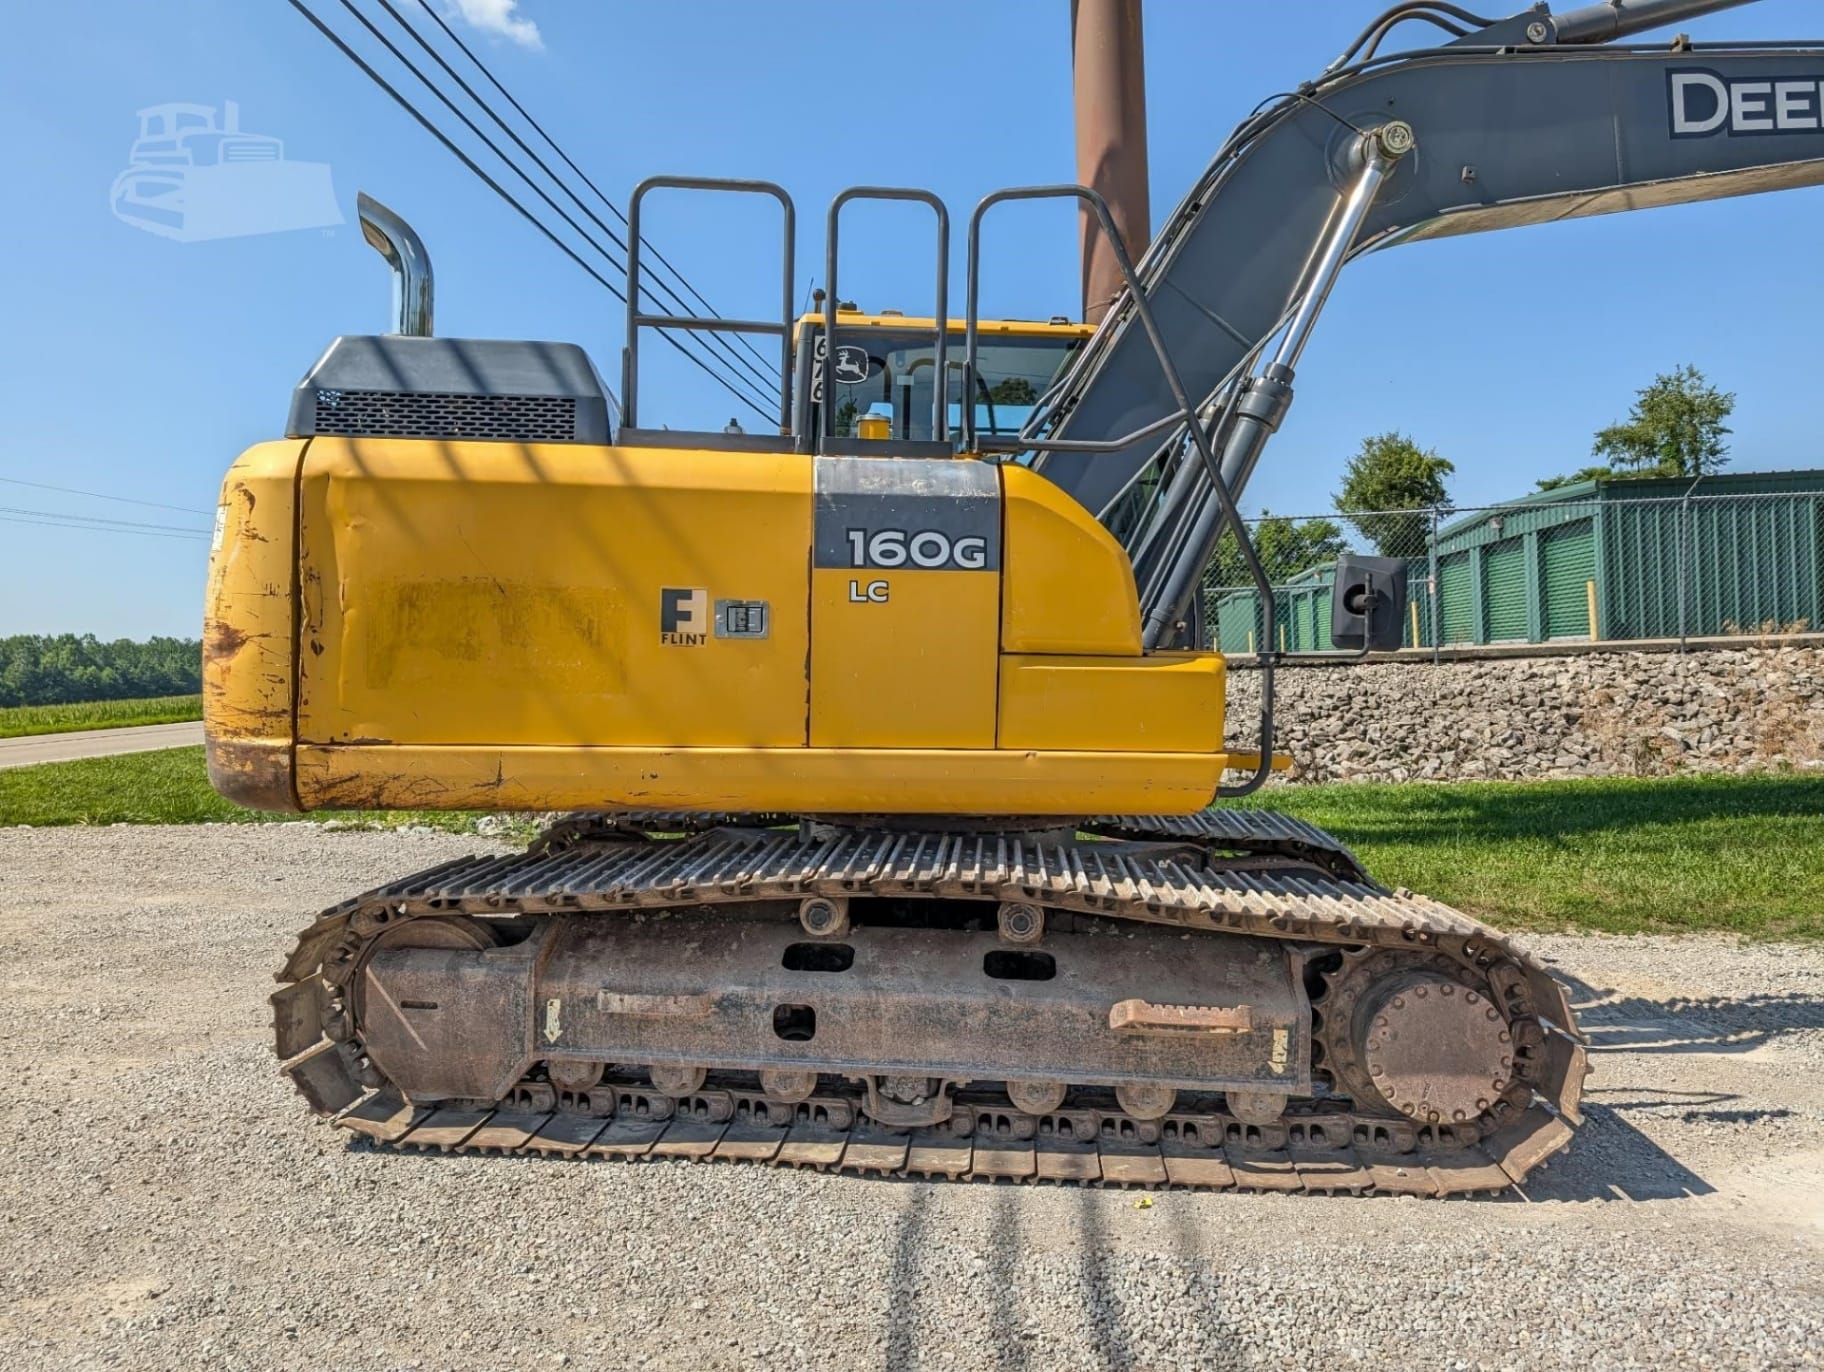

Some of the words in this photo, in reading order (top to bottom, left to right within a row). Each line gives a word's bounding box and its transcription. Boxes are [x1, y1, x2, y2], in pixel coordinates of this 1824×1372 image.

[1672, 73, 1824, 133] DEE
[813, 337, 826, 401] 676
[848, 530, 986, 569] 160G
[850, 580, 889, 602] LC
[661, 633, 707, 645] FLINT
